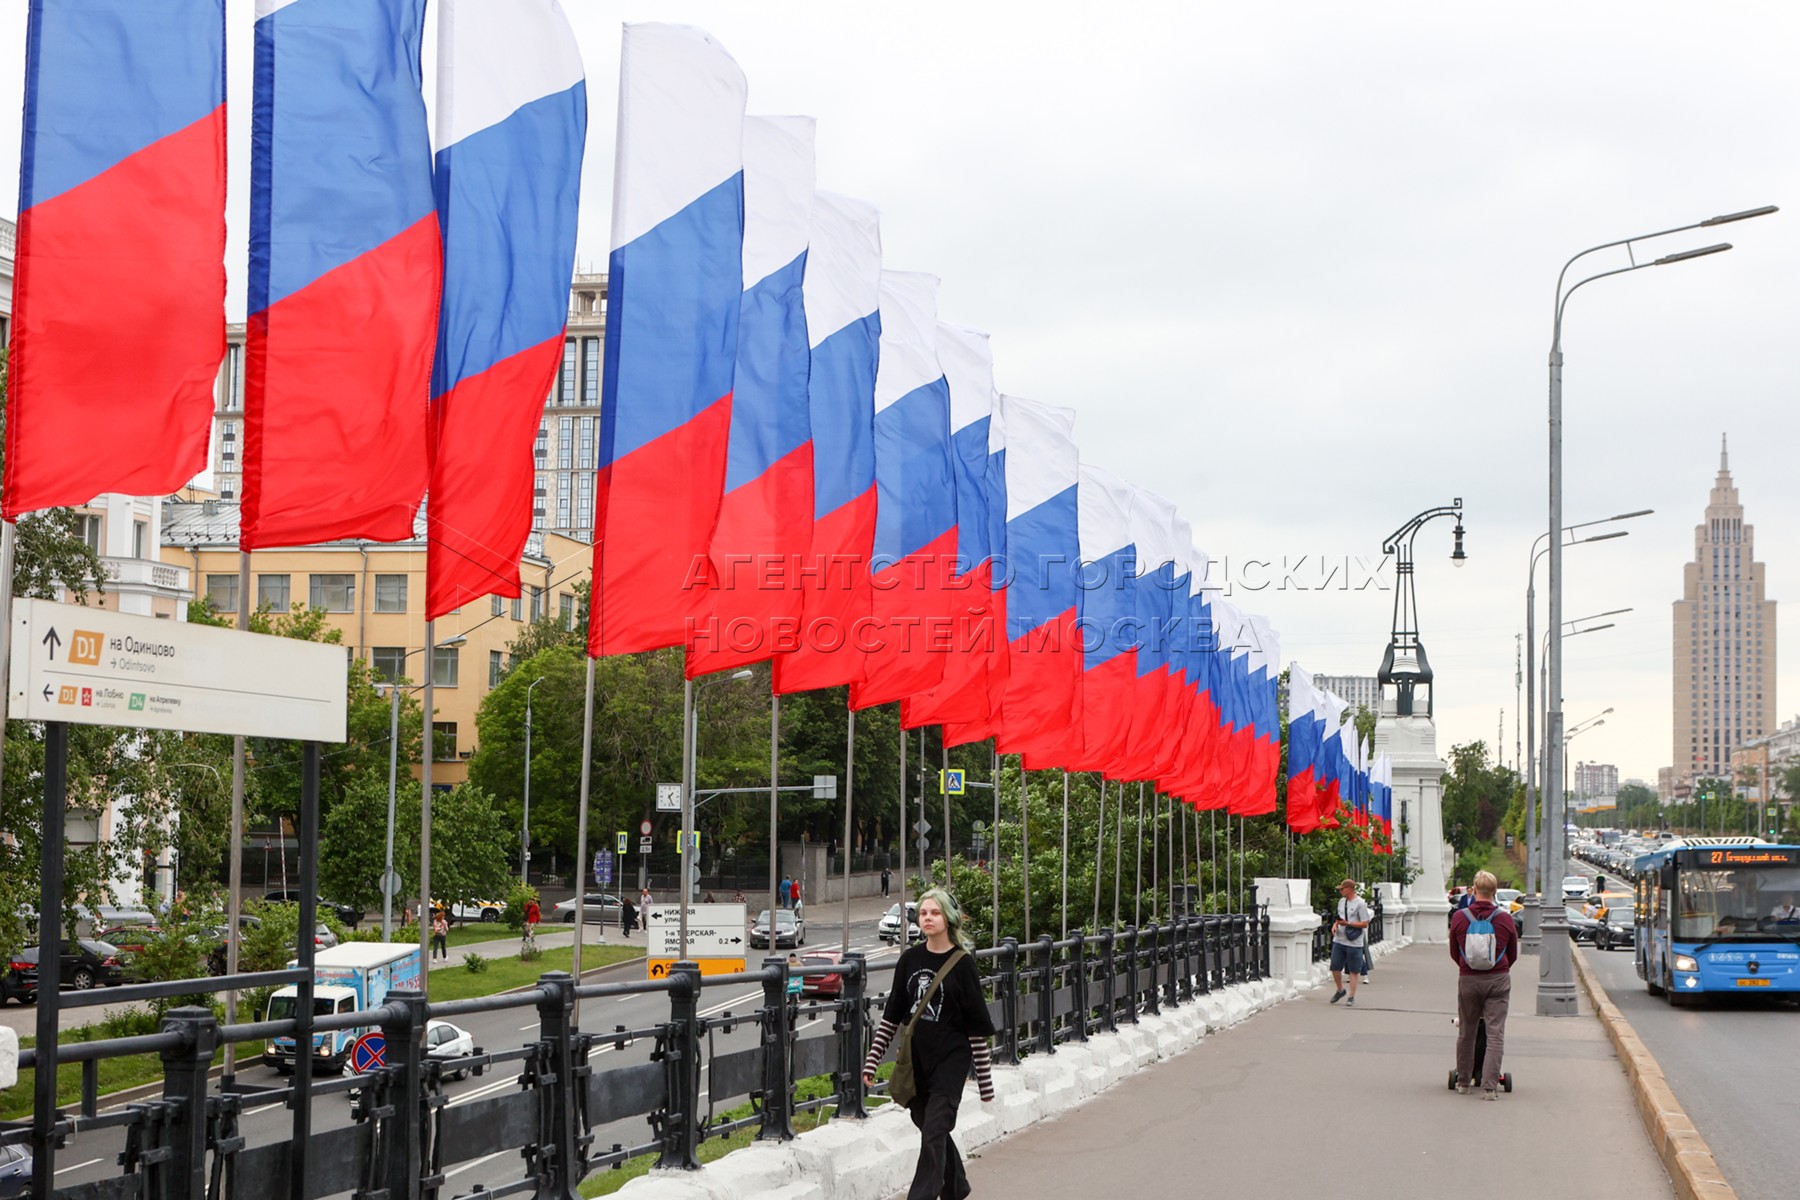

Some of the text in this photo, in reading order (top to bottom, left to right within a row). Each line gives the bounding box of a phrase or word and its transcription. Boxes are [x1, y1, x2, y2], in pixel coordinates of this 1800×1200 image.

[76, 635, 175, 660] D1 на Одинцово
[119, 657, 156, 673] Odintsovo
[62, 688, 124, 702] D1 на Лобню
[131, 695, 144, 709] D4
[1711, 851, 1723, 864] 27
[664, 908, 696, 916] НИЖЯЯ
